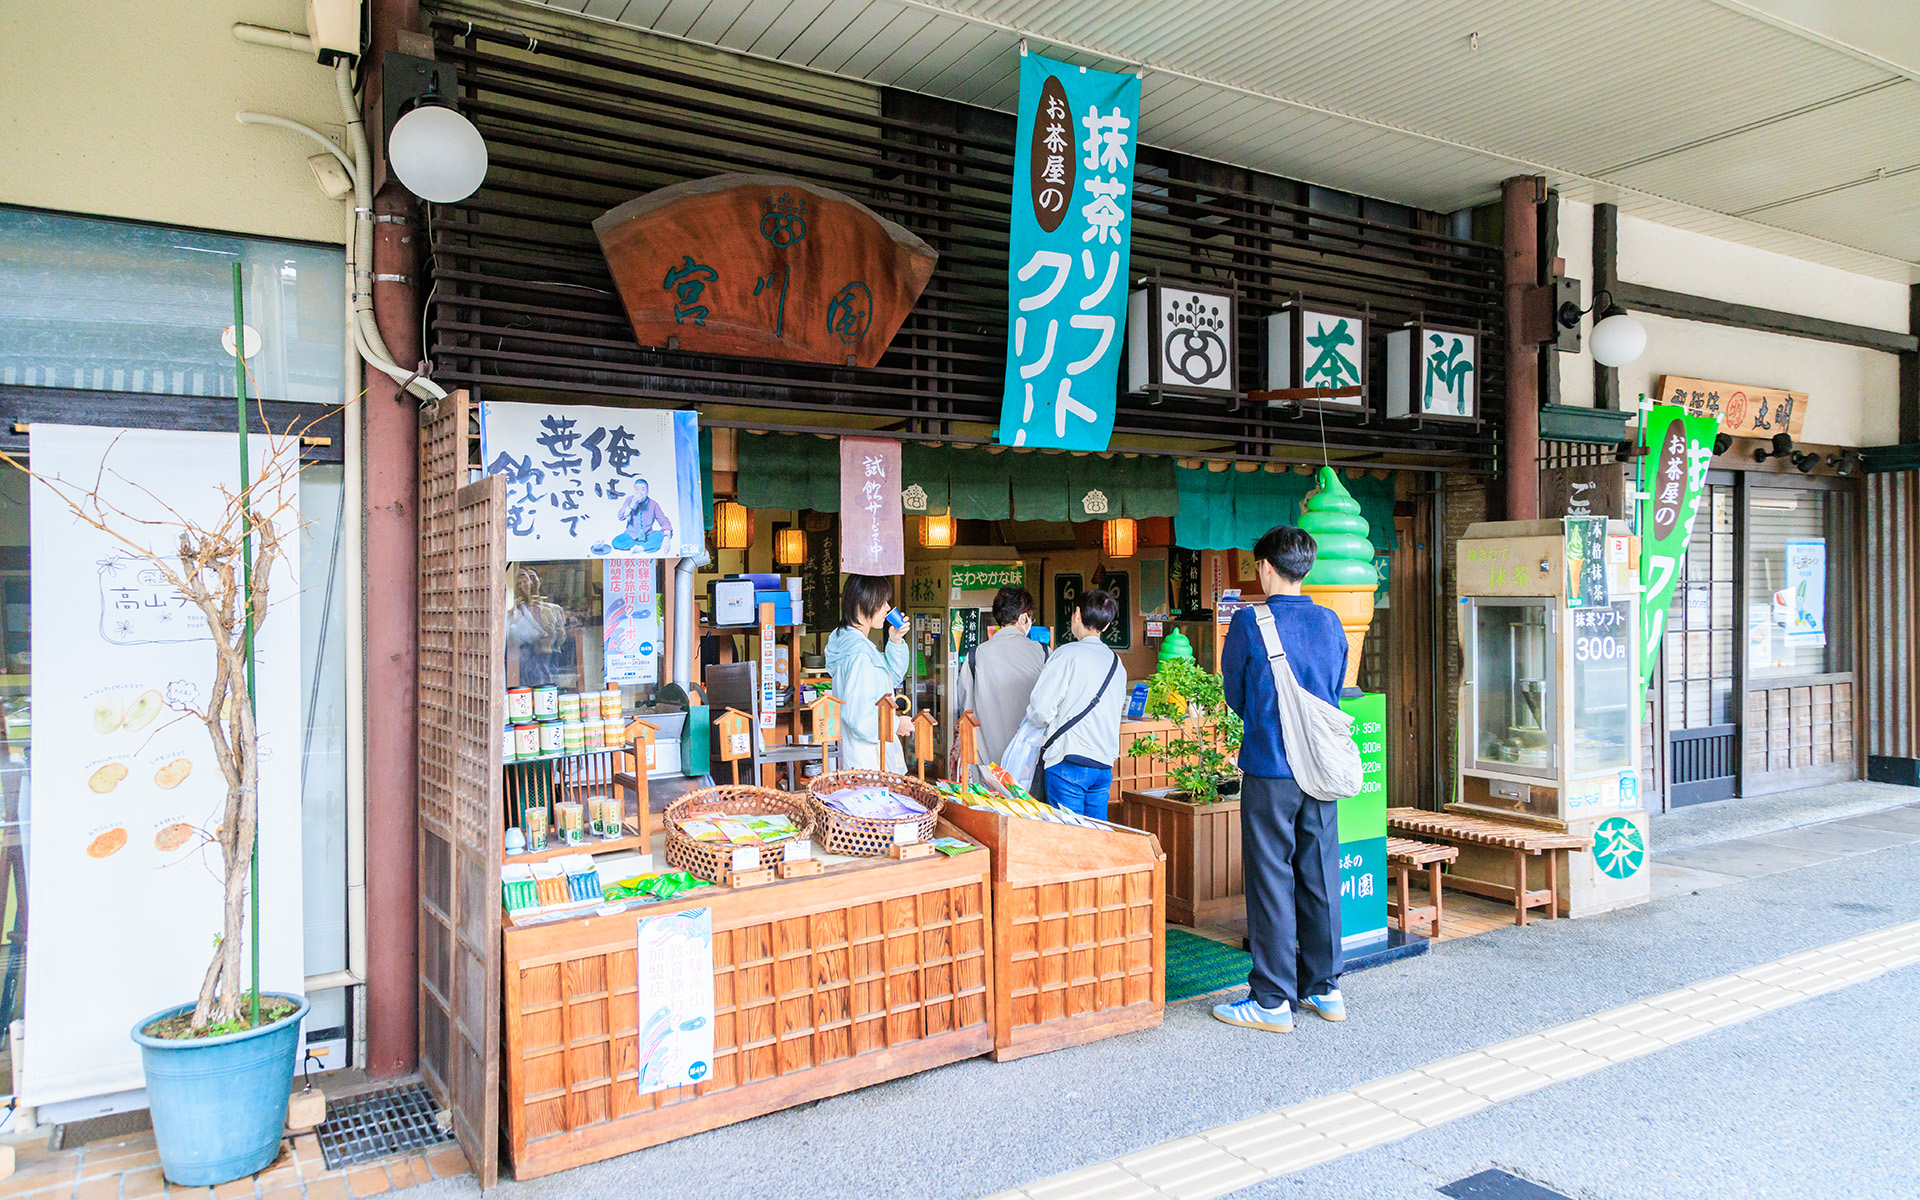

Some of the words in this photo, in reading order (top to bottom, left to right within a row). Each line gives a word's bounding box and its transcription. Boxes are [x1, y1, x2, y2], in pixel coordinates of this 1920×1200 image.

[1039, 94, 1069, 212] お茶屋の
[664, 256, 873, 345] 宮川園
[1055, 105, 1131, 438] 抹茶ソフト
[1305, 318, 1361, 401] 茶
[1424, 333, 1474, 416] 所
[536, 415, 591, 539] 葉っぱで
[580, 424, 642, 501] 俺は
[1655, 434, 1686, 526] お茶屋の
[862, 453, 887, 563] 試飲サービス中
[951, 570, 1022, 588] さわやかな味
[1489, 566, 1531, 588] 抹茶
[1592, 521, 1605, 602] 本格抹茶
[1106, 579, 1122, 643] 白茶
[1575, 610, 1626, 627] 抹茶ソフト
[1575, 636, 1626, 661] 300円
[1362, 721, 1382, 734] 350円
[1362, 742, 1382, 754] 300円
[1361, 781, 1382, 793] 300円
[1362, 761, 1382, 774] 220円
[1597, 818, 1644, 872] 茶
[648, 947, 665, 999] 加盟店
[669, 943, 686, 1078] 教育旅行クーポン
